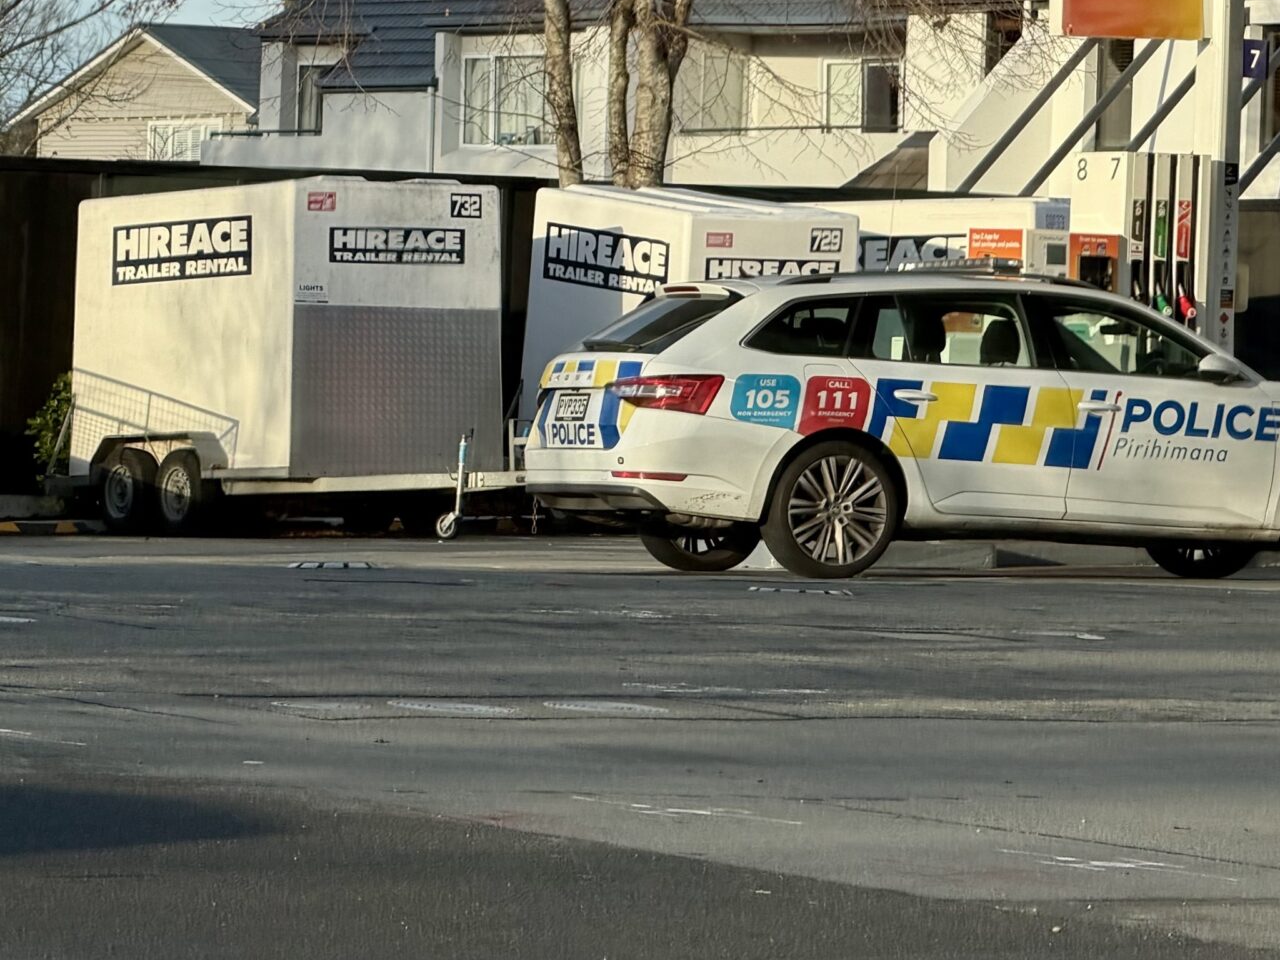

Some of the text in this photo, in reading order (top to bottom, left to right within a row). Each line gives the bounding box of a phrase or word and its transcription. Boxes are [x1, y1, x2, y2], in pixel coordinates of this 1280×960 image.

[1250, 49, 1261, 69] 7
[1077, 157, 1121, 181] 8 7
[451, 195, 481, 217] 732
[117, 220, 248, 261] HIREACE
[333, 229, 461, 251] HIREACE
[812, 229, 841, 252] 729
[334, 252, 397, 262] TRAILER
[402, 252, 461, 263] RENTAL
[548, 226, 667, 277] HIREACE
[116, 262, 180, 282] TRAILER
[185, 257, 248, 276] RENTAL
[547, 262, 605, 286] TRAILER
[299, 284, 324, 292] LIGHTS
[760, 378, 777, 387] USE
[828, 380, 850, 388] CALL
[745, 389, 791, 409] 105
[817, 390, 858, 410] 111
[817, 410, 855, 418] EMERGENCY
[551, 423, 596, 445] POLICE
[1112, 437, 1229, 463] Pirihimana
